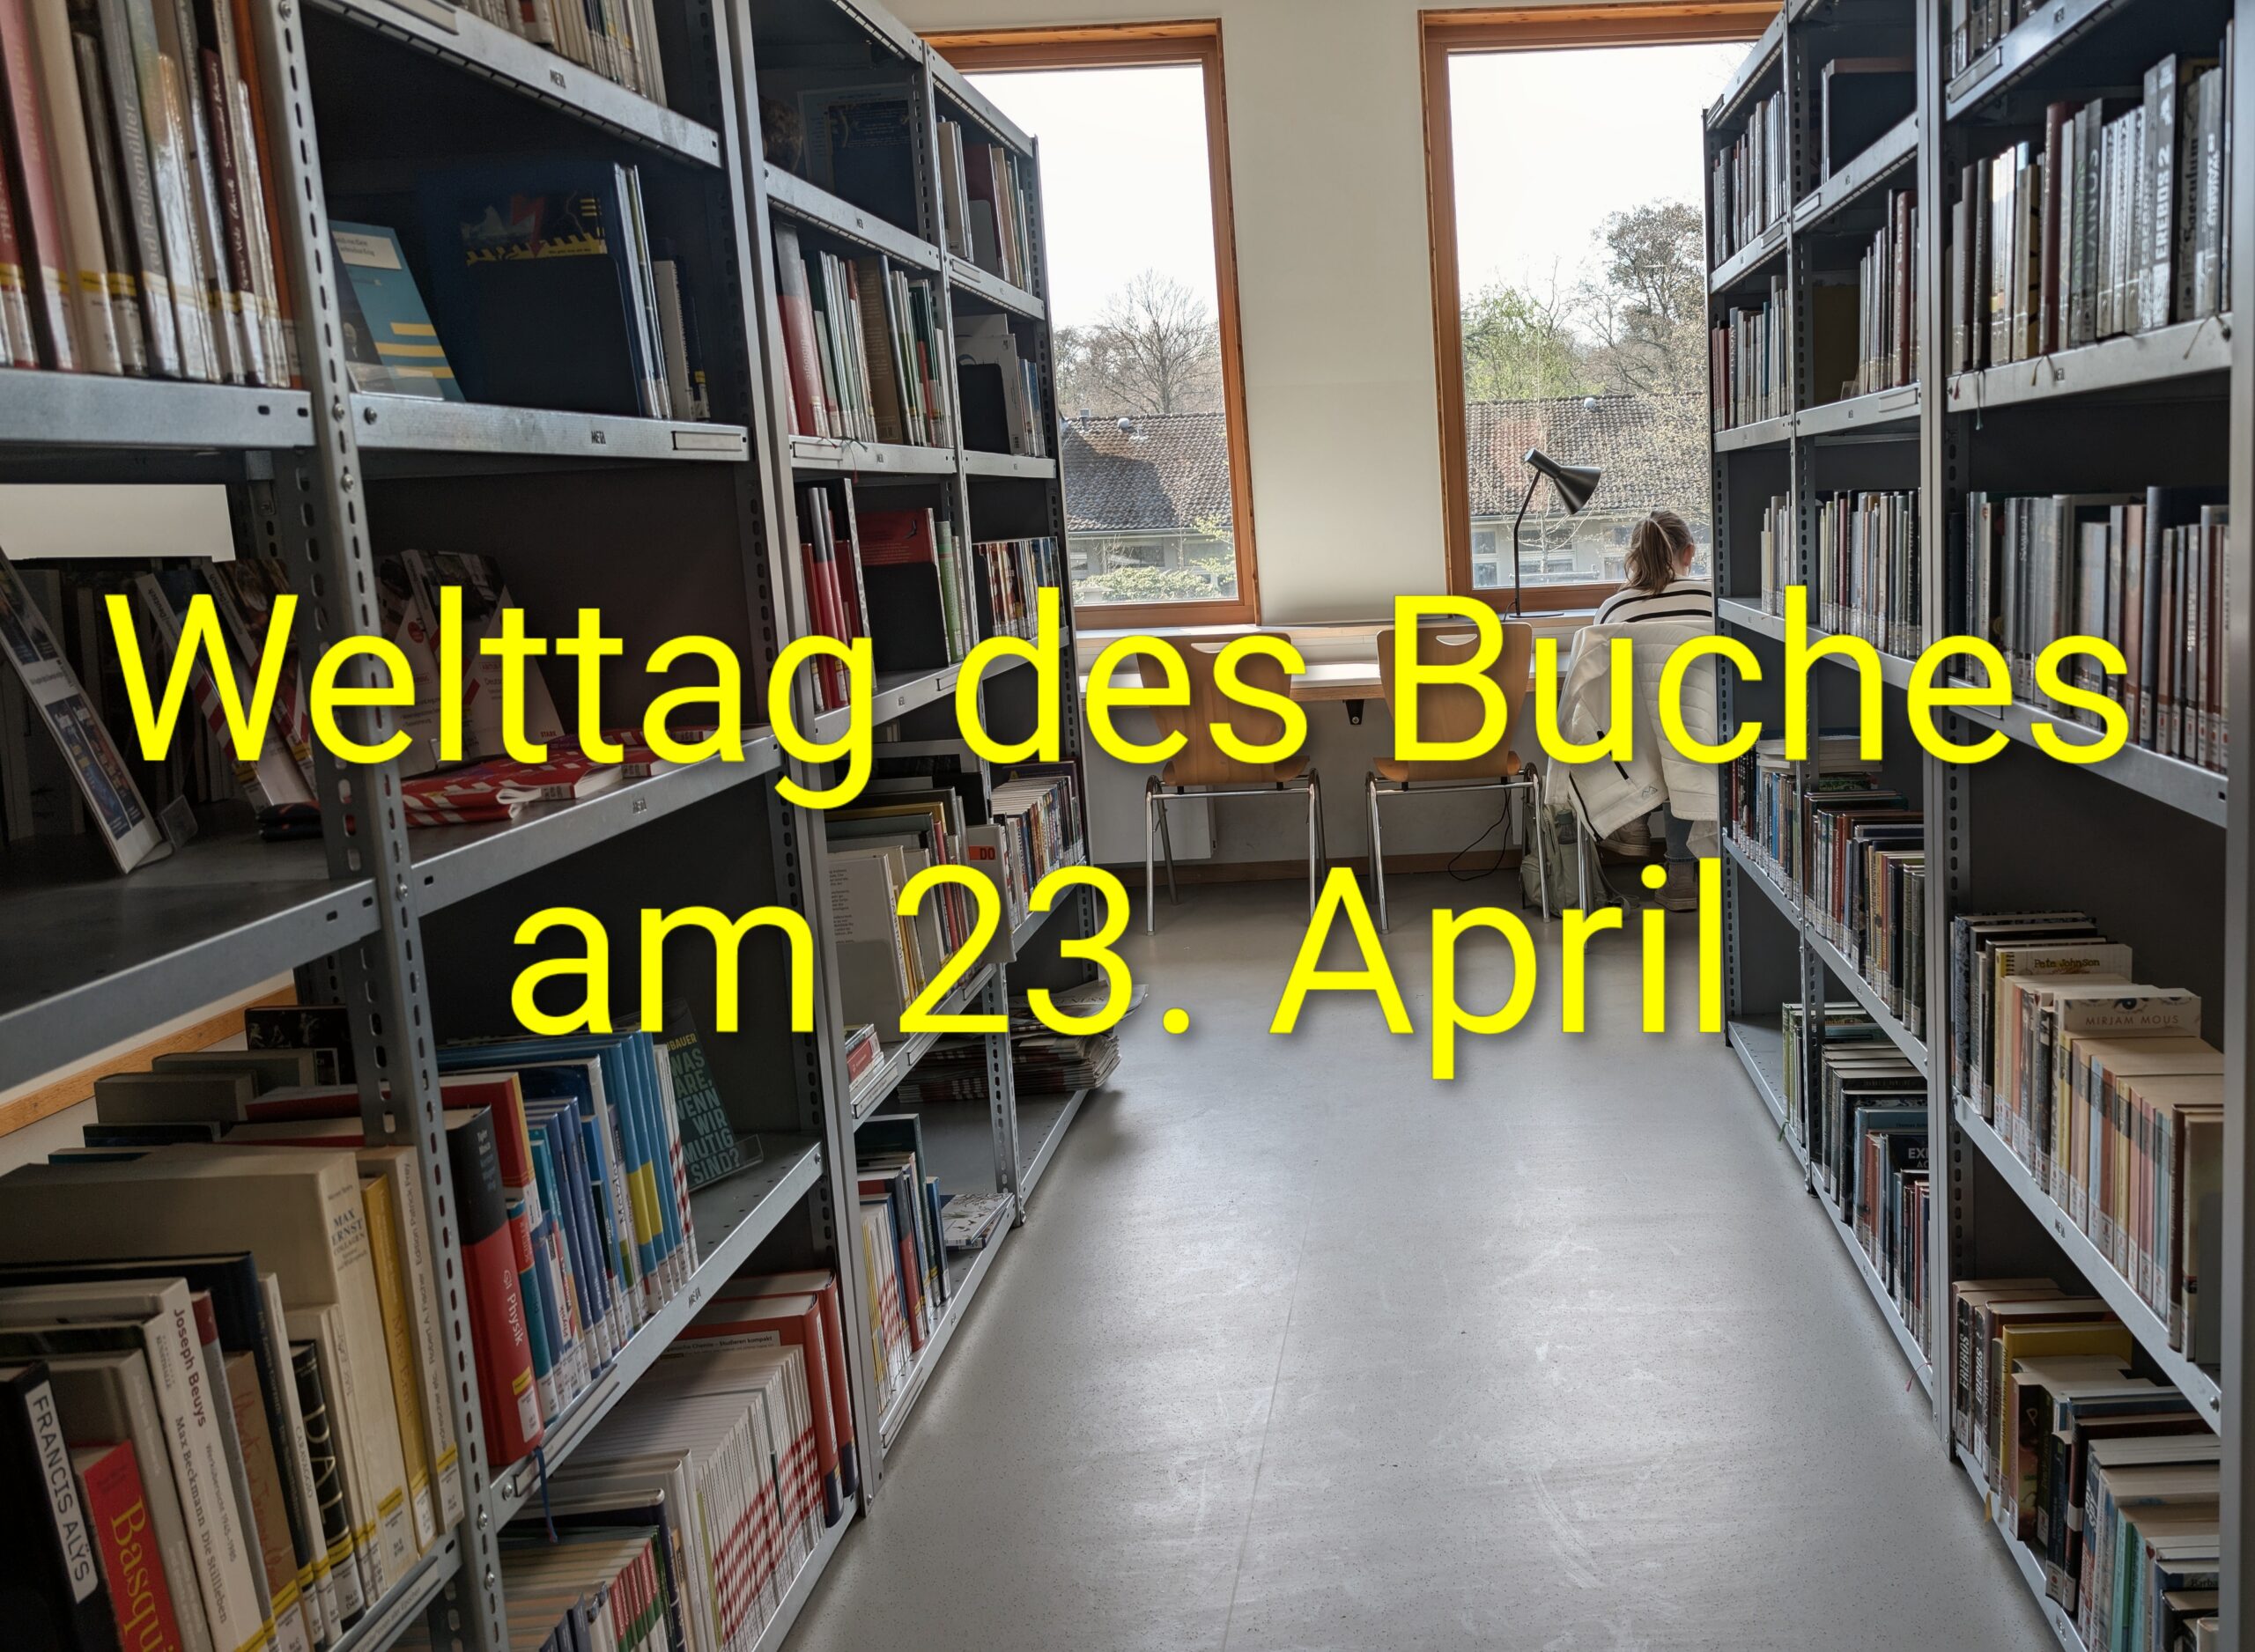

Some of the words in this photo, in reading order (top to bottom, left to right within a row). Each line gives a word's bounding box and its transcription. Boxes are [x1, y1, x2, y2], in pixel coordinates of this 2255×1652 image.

[118, 98, 158, 232] Felixmüller
[2158, 144, 2171, 165] 2
[2184, 137, 2199, 243] Saeculum
[2155, 169, 2172, 261] EREBOS
[591, 431, 606, 445] META
[2034, 958, 2057, 968] Pete
[2085, 1014, 2133, 1026] MIRJAM
[2140, 1014, 2178, 1024] MOUS
[670, 1049, 706, 1076] WAS
[692, 1109, 728, 1137] WIR
[683, 1128, 734, 1166] MUTIG
[690, 1147, 741, 1184] SIND?
[398, 1162, 414, 1187] Frey
[333, 1209, 356, 1228] MAX
[402, 1186, 419, 1226] Patrick
[330, 1218, 363, 1246] ERNST
[408, 1227, 425, 1265] Edition
[414, 1272, 432, 1312] Fischer
[506, 1293, 524, 1346] Physik
[422, 1327, 440, 1364] Robert
[719, 1338, 747, 1347] Studieren
[747, 1335, 773, 1346] kompakt
[174, 1309, 194, 1370] Joseph
[189, 1371, 207, 1427] Beuys
[1958, 1333, 1970, 1390] EREBOS
[1975, 1346, 1984, 1404] EREBOS
[175, 1416, 189, 1450] Max
[33, 1395, 74, 1515] FRANCIS
[295, 1425, 314, 1499] CARAVAGGIO
[181, 1449, 206, 1527] Beckmann
[201, 1529, 212, 1555] Die
[110, 1495, 174, 1652] Basqu
[207, 1555, 227, 1625] Stillleben
